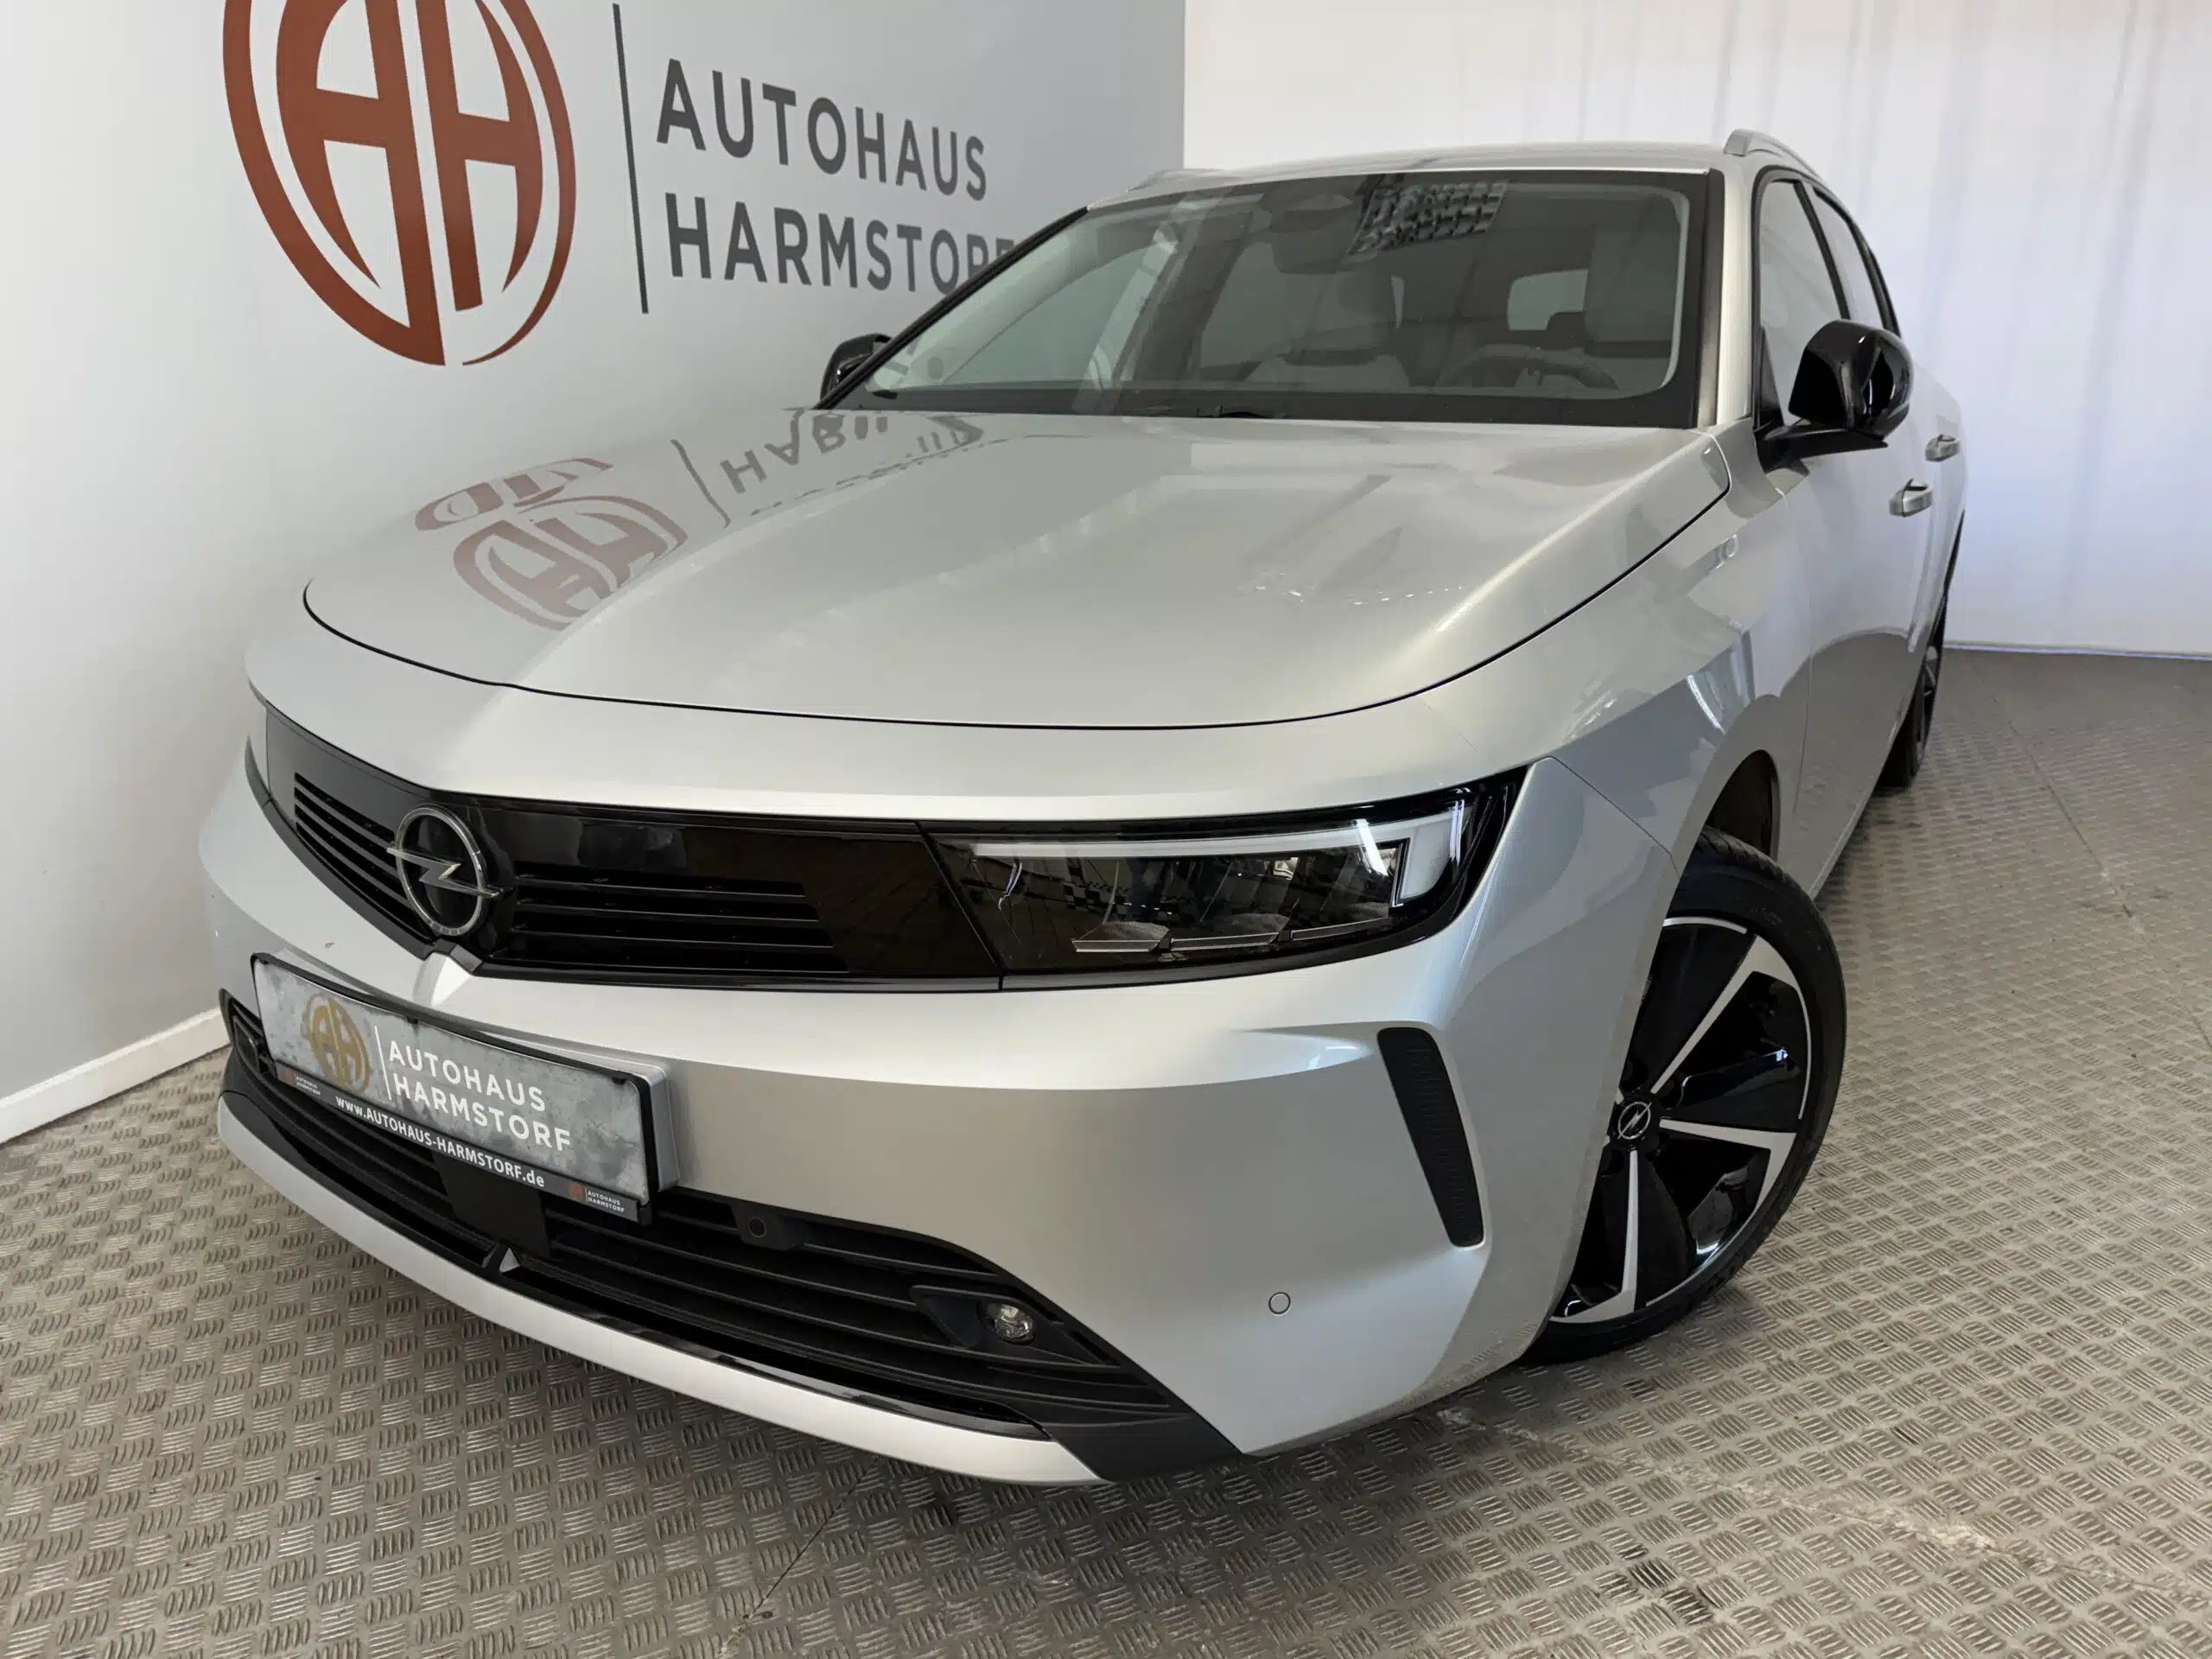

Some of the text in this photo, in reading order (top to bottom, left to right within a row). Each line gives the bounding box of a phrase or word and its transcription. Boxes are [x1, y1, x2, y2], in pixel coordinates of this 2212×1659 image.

[657, 59, 988, 202] AUTOHAUS
[389, 1039, 546, 1112] AUTOHAUS
[393, 1072, 571, 1152] HARMSTORF
[335, 1096, 545, 1188] www.AUTOHAUS-HARMSTORF.de
[588, 1190, 621, 1206] AUTOHAUS
[588, 1197, 625, 1213] HARMSTORF
